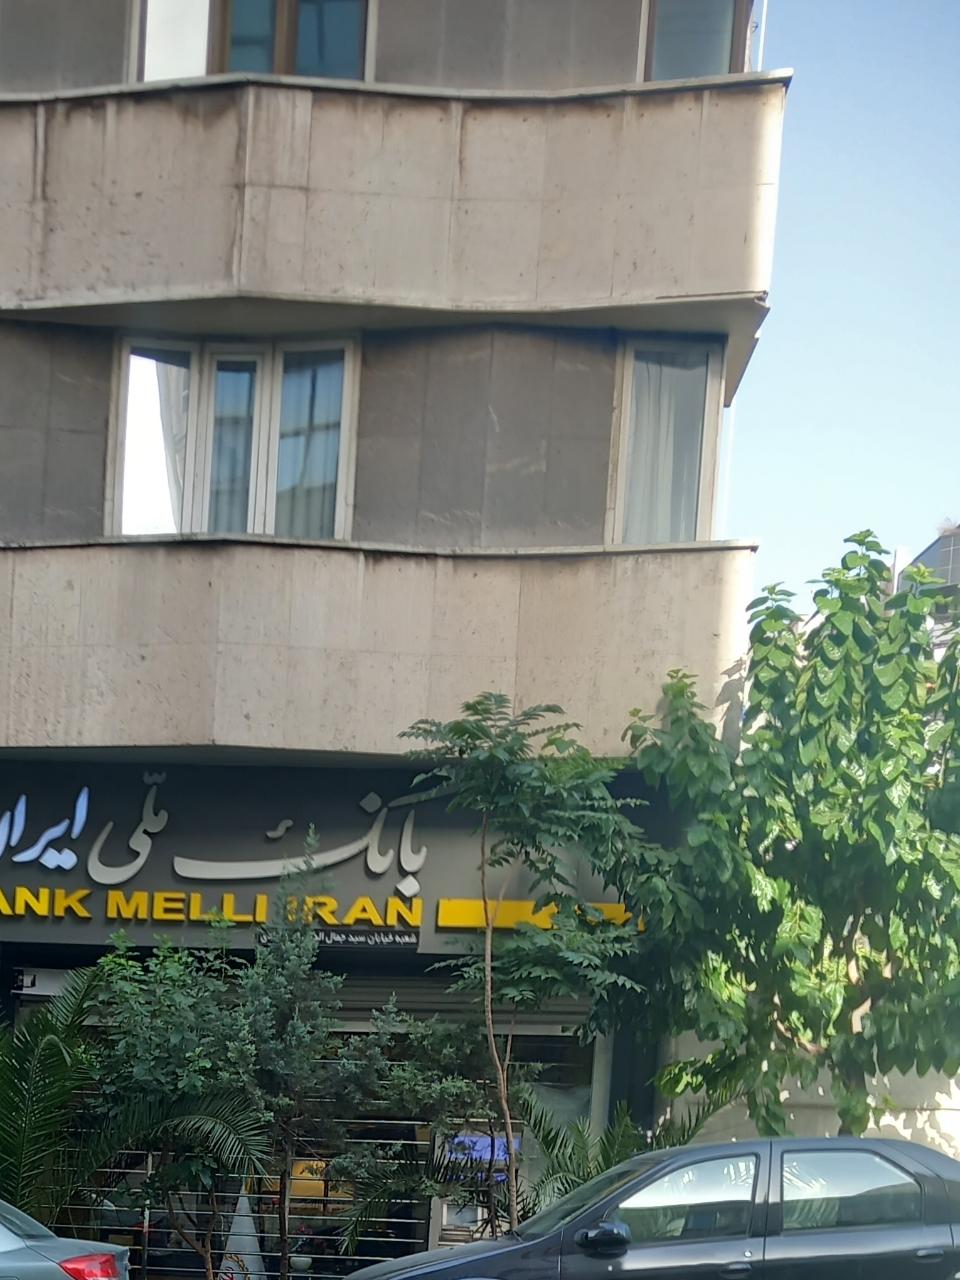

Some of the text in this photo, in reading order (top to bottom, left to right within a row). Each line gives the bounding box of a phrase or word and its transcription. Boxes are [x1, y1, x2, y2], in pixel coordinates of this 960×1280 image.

[173, 785, 462, 898] بانک
[106, 889, 269, 924] MELLI
[287, 895, 422, 928] IRAN
[395, 932, 418, 945] شعبه
